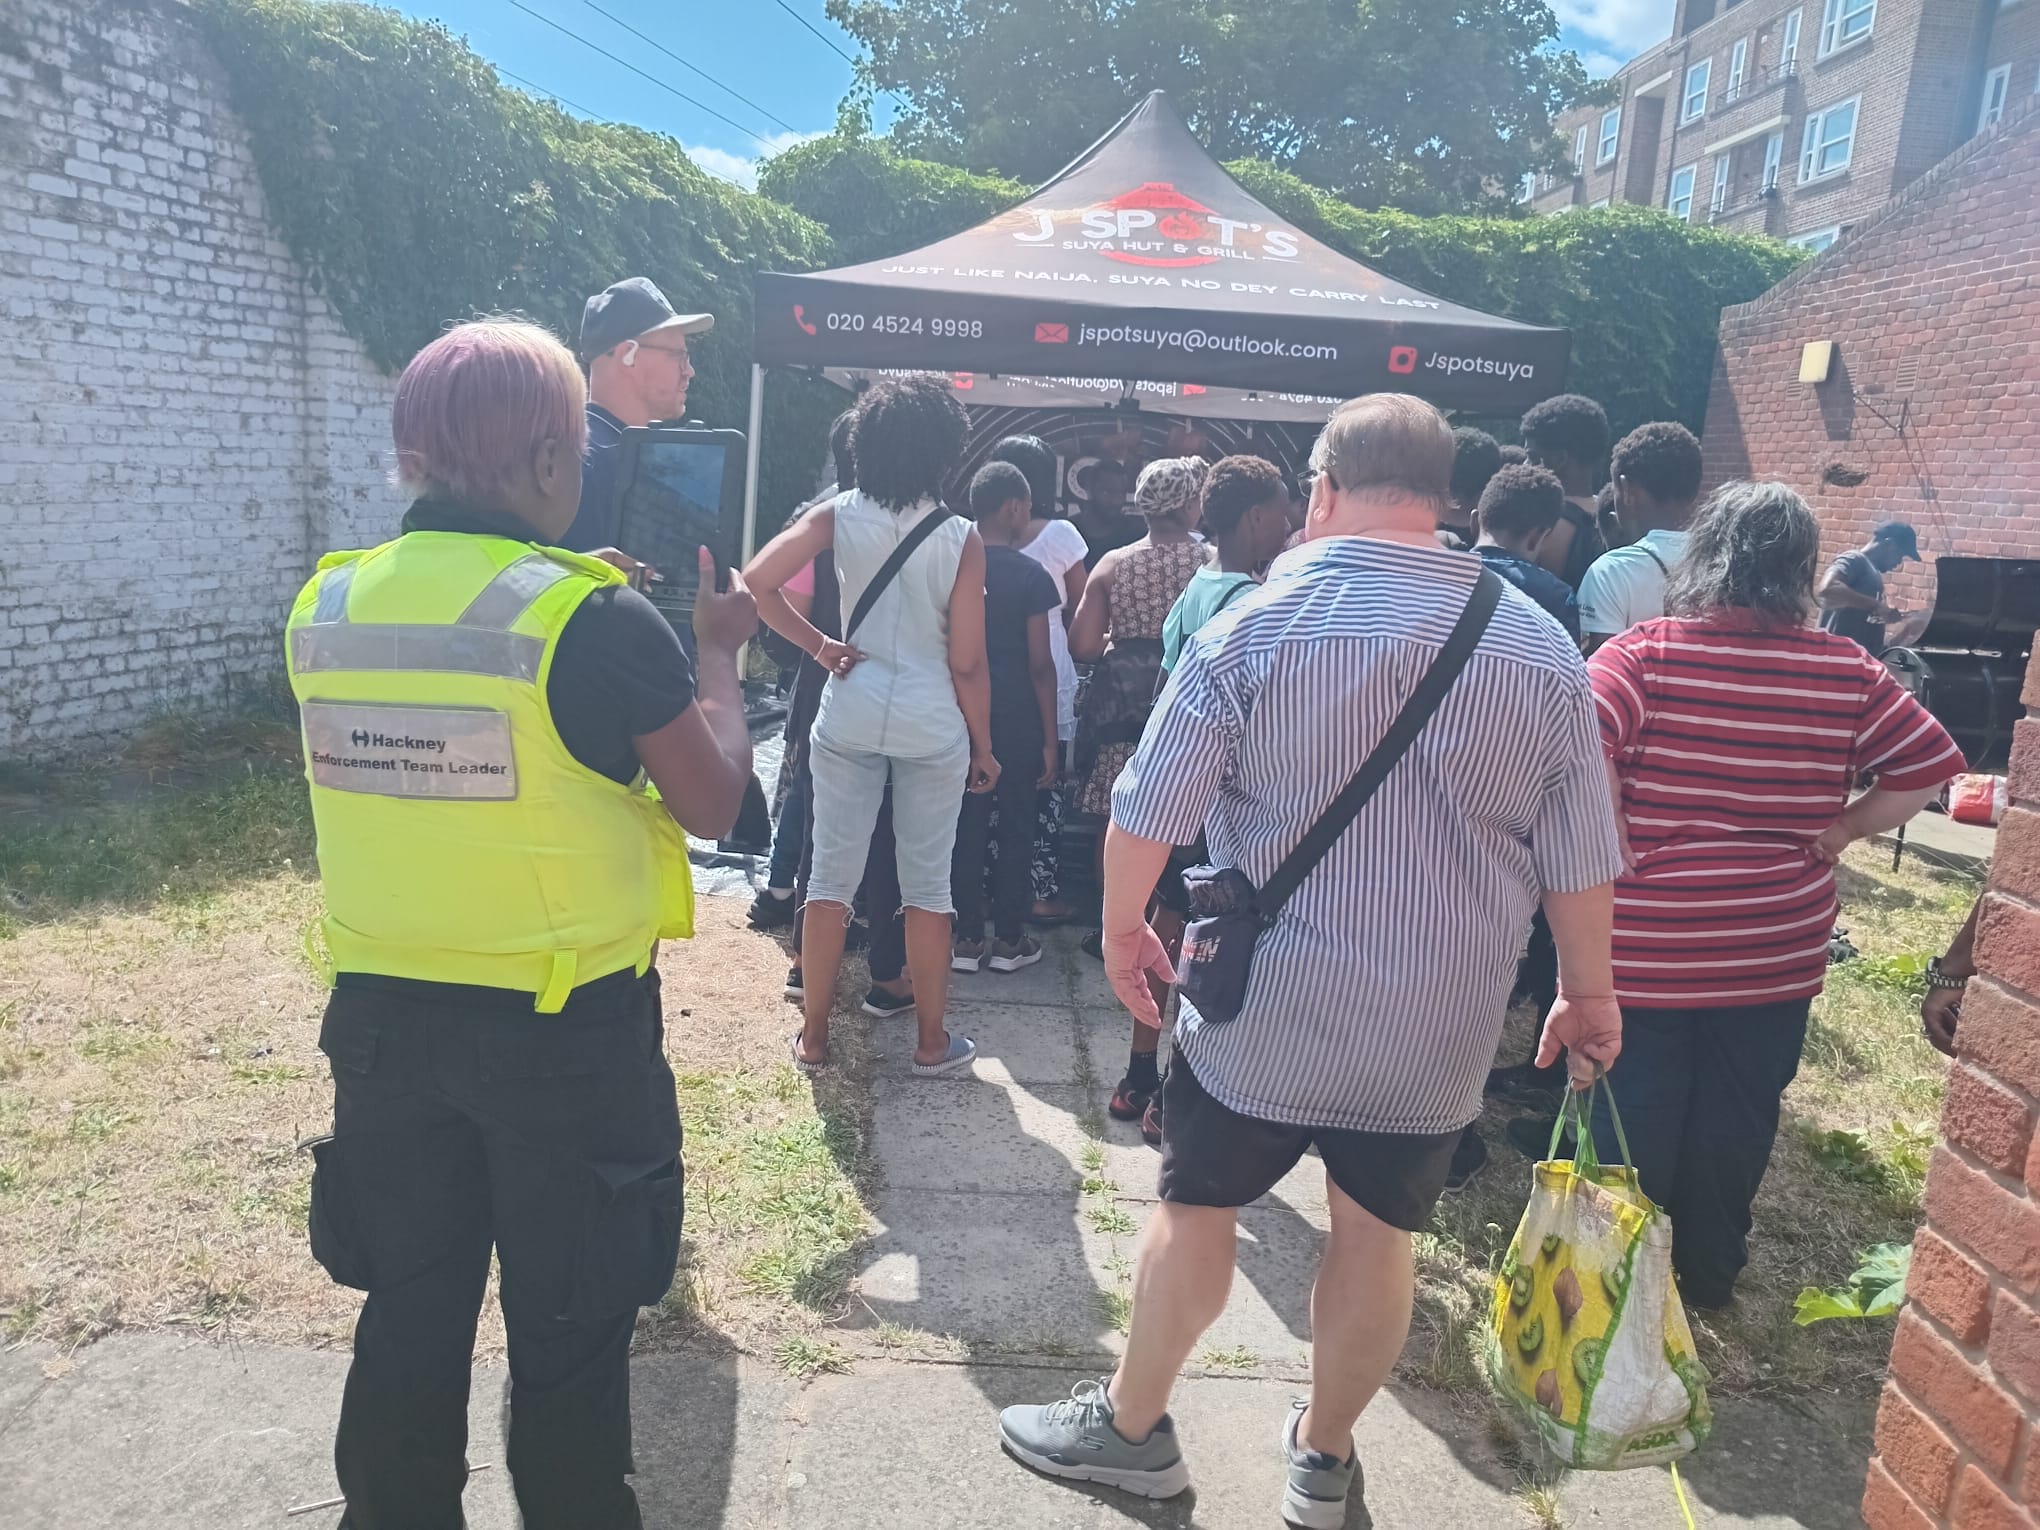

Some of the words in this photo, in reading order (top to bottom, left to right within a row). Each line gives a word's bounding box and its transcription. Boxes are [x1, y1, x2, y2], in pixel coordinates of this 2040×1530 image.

[1012, 208, 1055, 242] J
[1062, 241, 1115, 251] SUYA
[1122, 241, 1165, 252] HUT
[1173, 243, 1189, 254] &
[1197, 245, 1256, 261] GRILL
[881, 265, 945, 276] JUST
[953, 267, 1005, 278] LIKE
[1108, 273, 1170, 286] SUYA
[1181, 278, 1221, 290] NO
[1230, 282, 1279, 294] DEY
[1288, 287, 1369, 302] CARRY
[1378, 296, 1440, 310] LAST
[826, 312, 866, 332] 020
[871, 315, 925, 335] 4524
[930, 317, 984, 339] 9998
[1077, 323, 1338, 360] jspotsuya@outlook.com
[1424, 351, 1534, 382] Jspotsuya
[372, 733, 447, 754] Hackney
[312, 751, 397, 771] Enforcement
[400, 758, 444, 774] Team
[448, 761, 508, 775] Leader
[1623, 1430, 1680, 1454] ASDA
